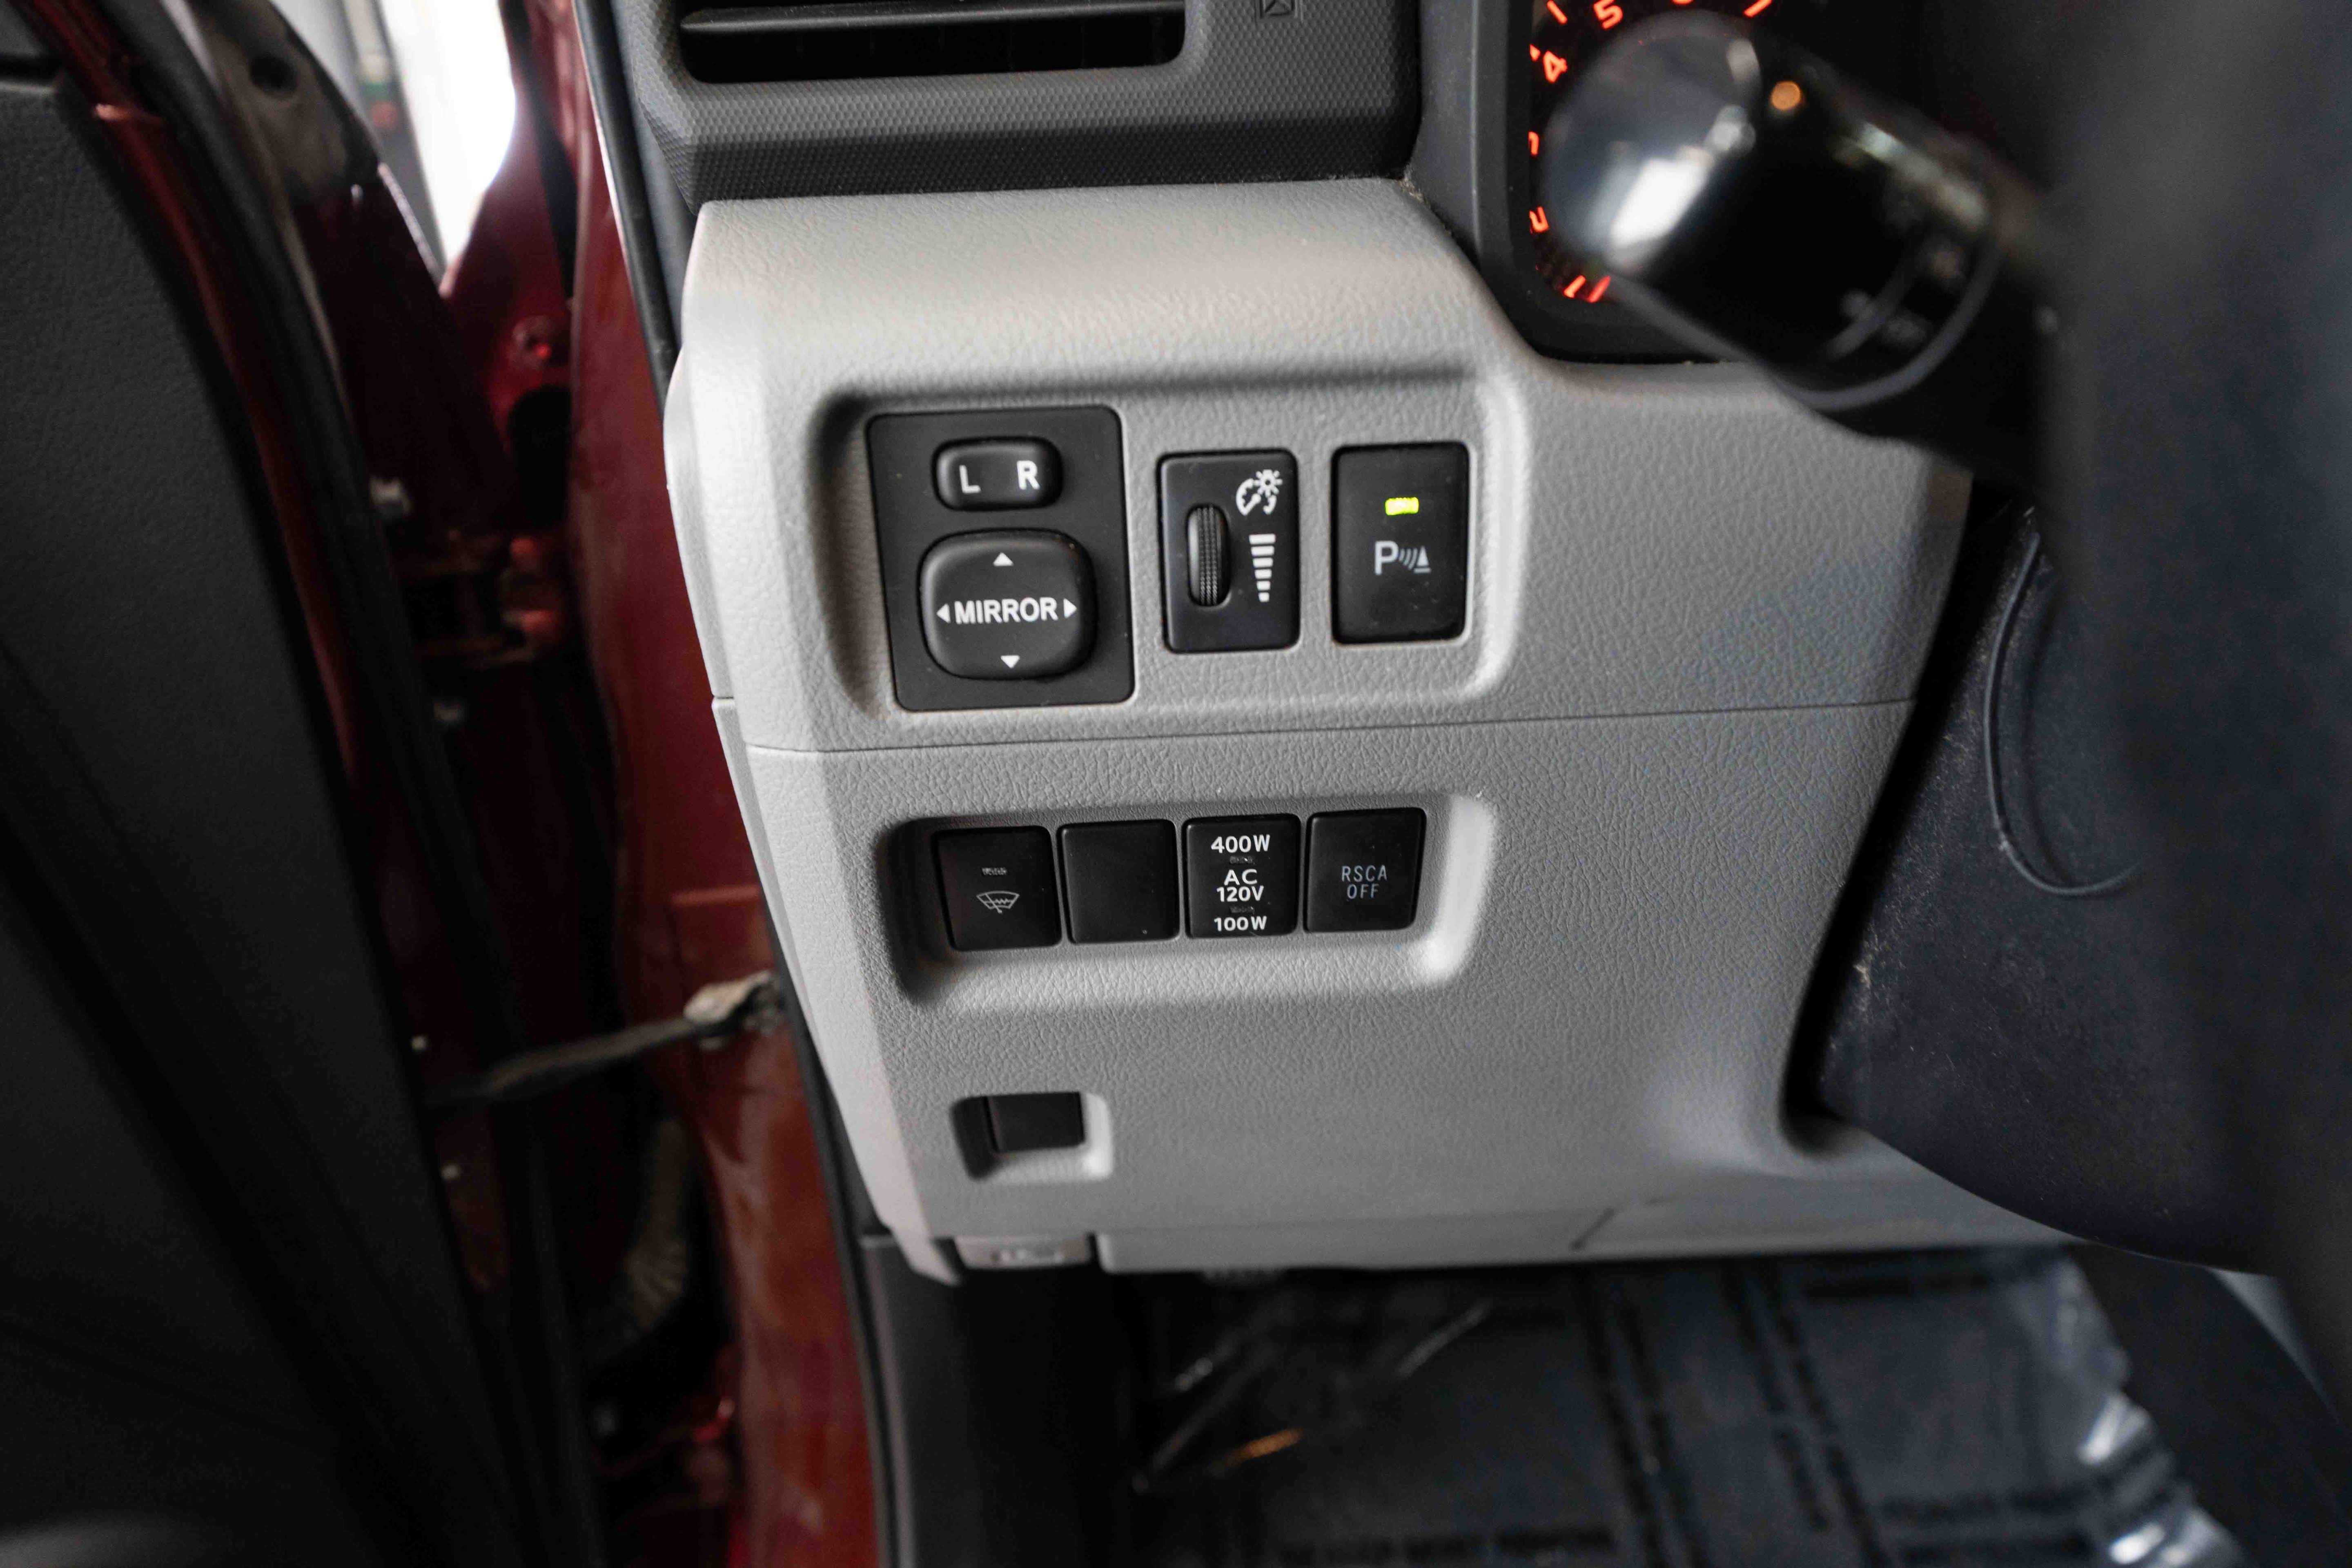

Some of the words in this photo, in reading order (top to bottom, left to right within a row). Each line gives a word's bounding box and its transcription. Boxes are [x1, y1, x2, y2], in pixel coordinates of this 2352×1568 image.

[1543, 51, 1568, 84] 4
[959, 464, 981, 494] L
[1017, 460, 1040, 490] R
[954, 597, 1059, 624] MIRROR
[1211, 834, 1270, 853] 400W
[1224, 869, 1258, 886] AC
[1341, 864, 1387, 882] RSCA
[1216, 885, 1264, 902] 120V
[1347, 883, 1379, 899] OFF
[1214, 915, 1267, 932] 100W
